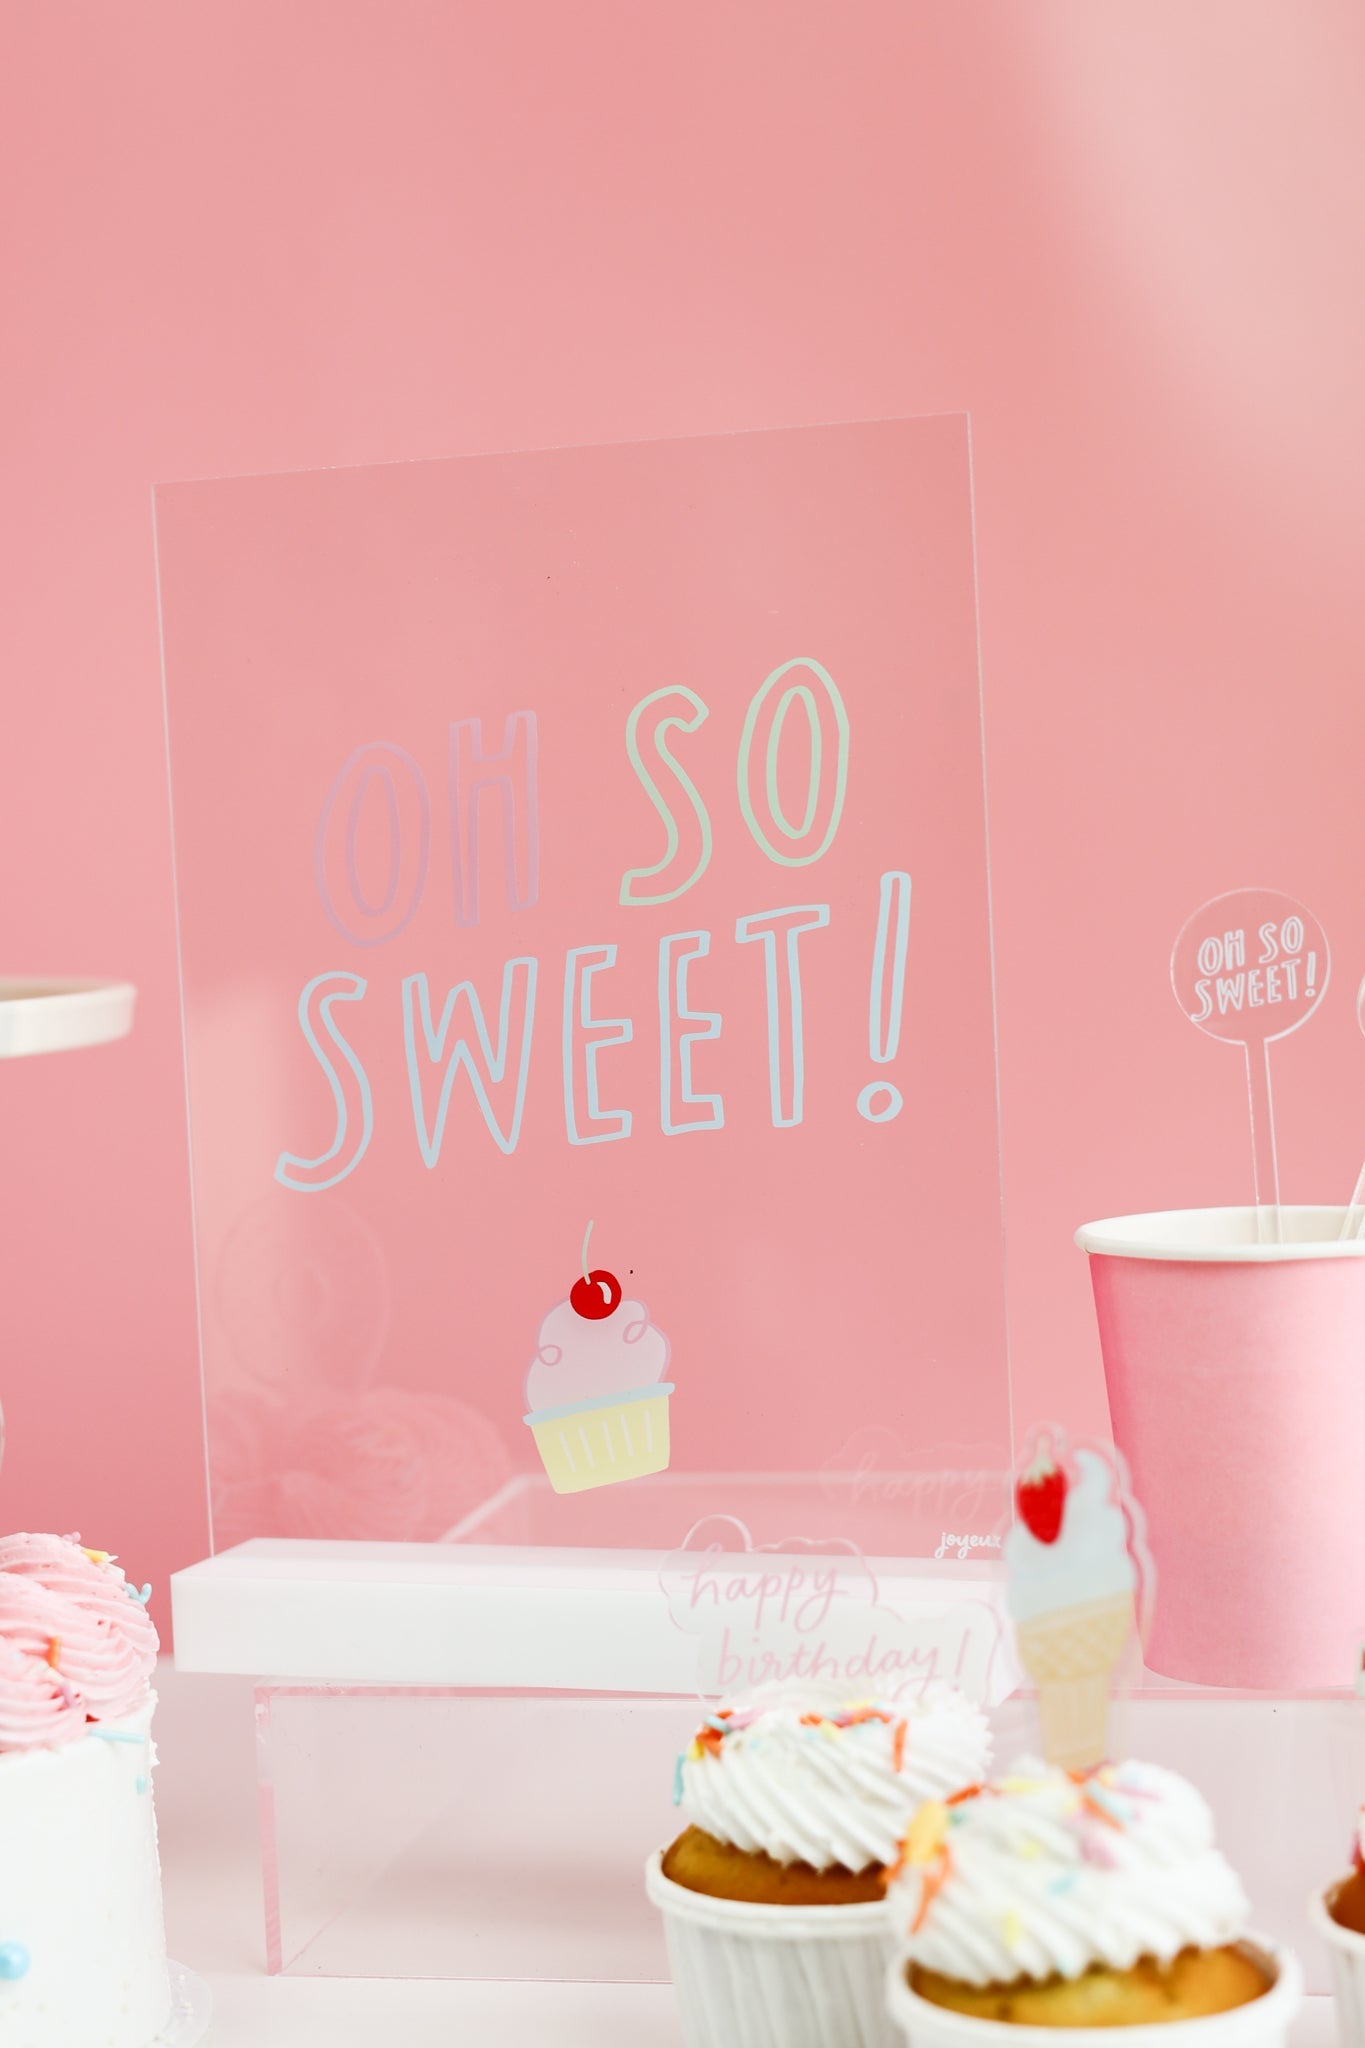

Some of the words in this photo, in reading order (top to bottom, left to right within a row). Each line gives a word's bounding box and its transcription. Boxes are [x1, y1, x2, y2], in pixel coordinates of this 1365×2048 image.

[314, 710, 539, 948] OH
[619, 657, 850, 906] SO
[1197, 929, 1245, 977] OH
[1258, 915, 1304, 964] SO
[1190, 951, 1317, 1022] SWEET!
[274, 871, 912, 1192] SWEET!
[849, 1451, 997, 1522] happy
[934, 1531, 1002, 1561] joyeux
[681, 1542, 849, 1634] happy
